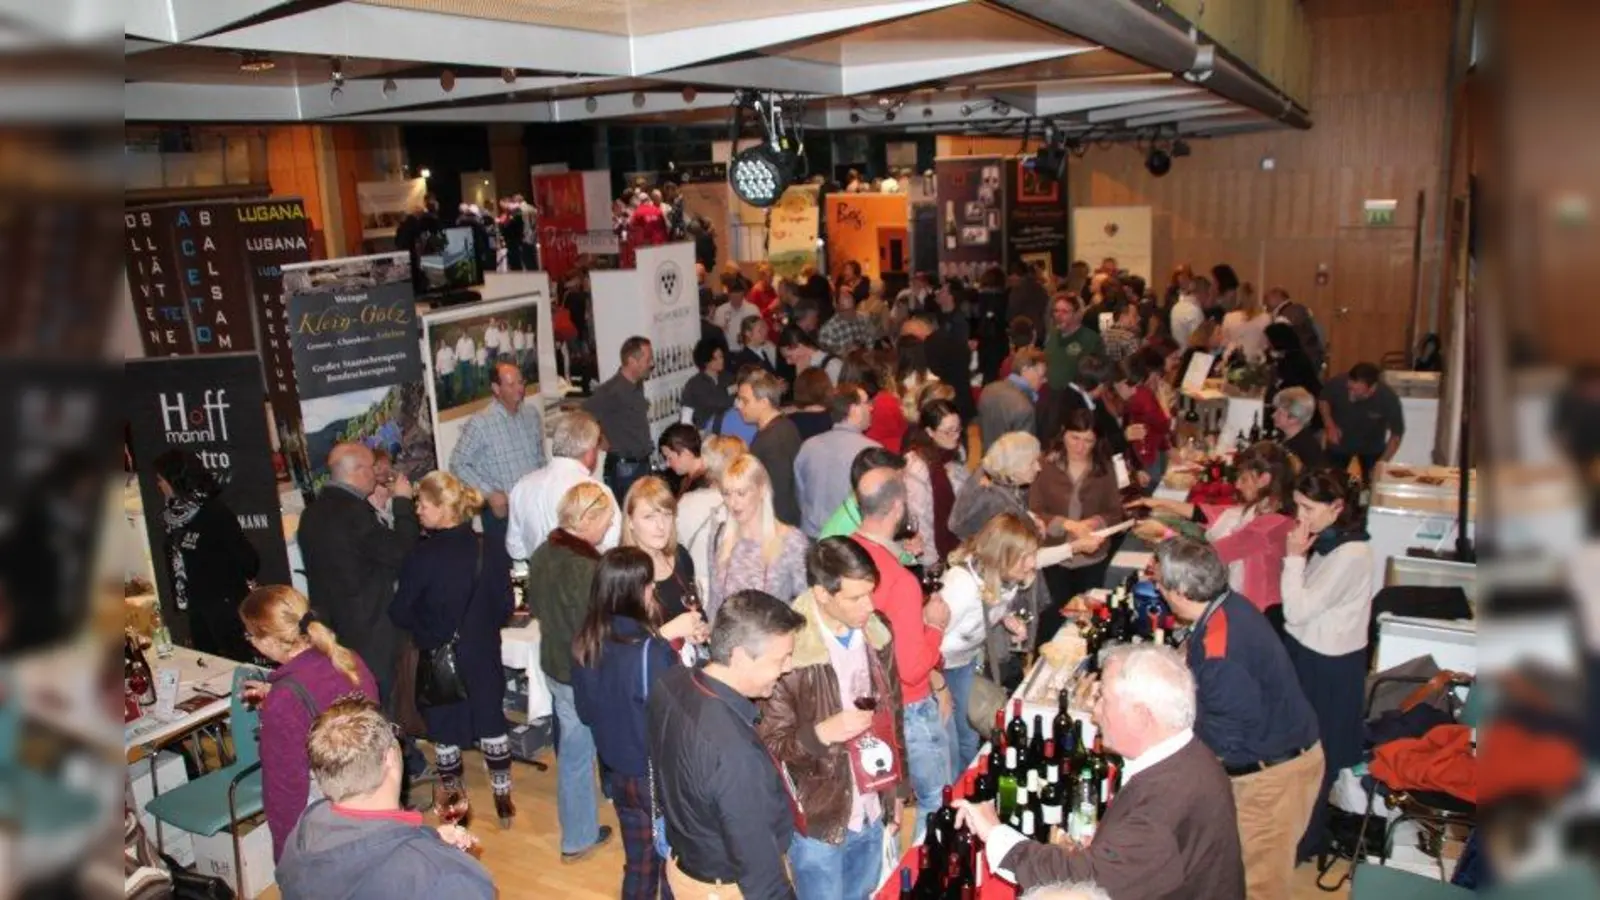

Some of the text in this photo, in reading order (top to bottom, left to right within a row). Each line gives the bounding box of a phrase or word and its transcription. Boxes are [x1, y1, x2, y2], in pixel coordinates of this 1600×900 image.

[237, 204, 305, 222] LUGANA
[246, 236, 308, 251] LUGANA
[159, 388, 231, 442] Hoff
[165, 430, 214, 443] mann
